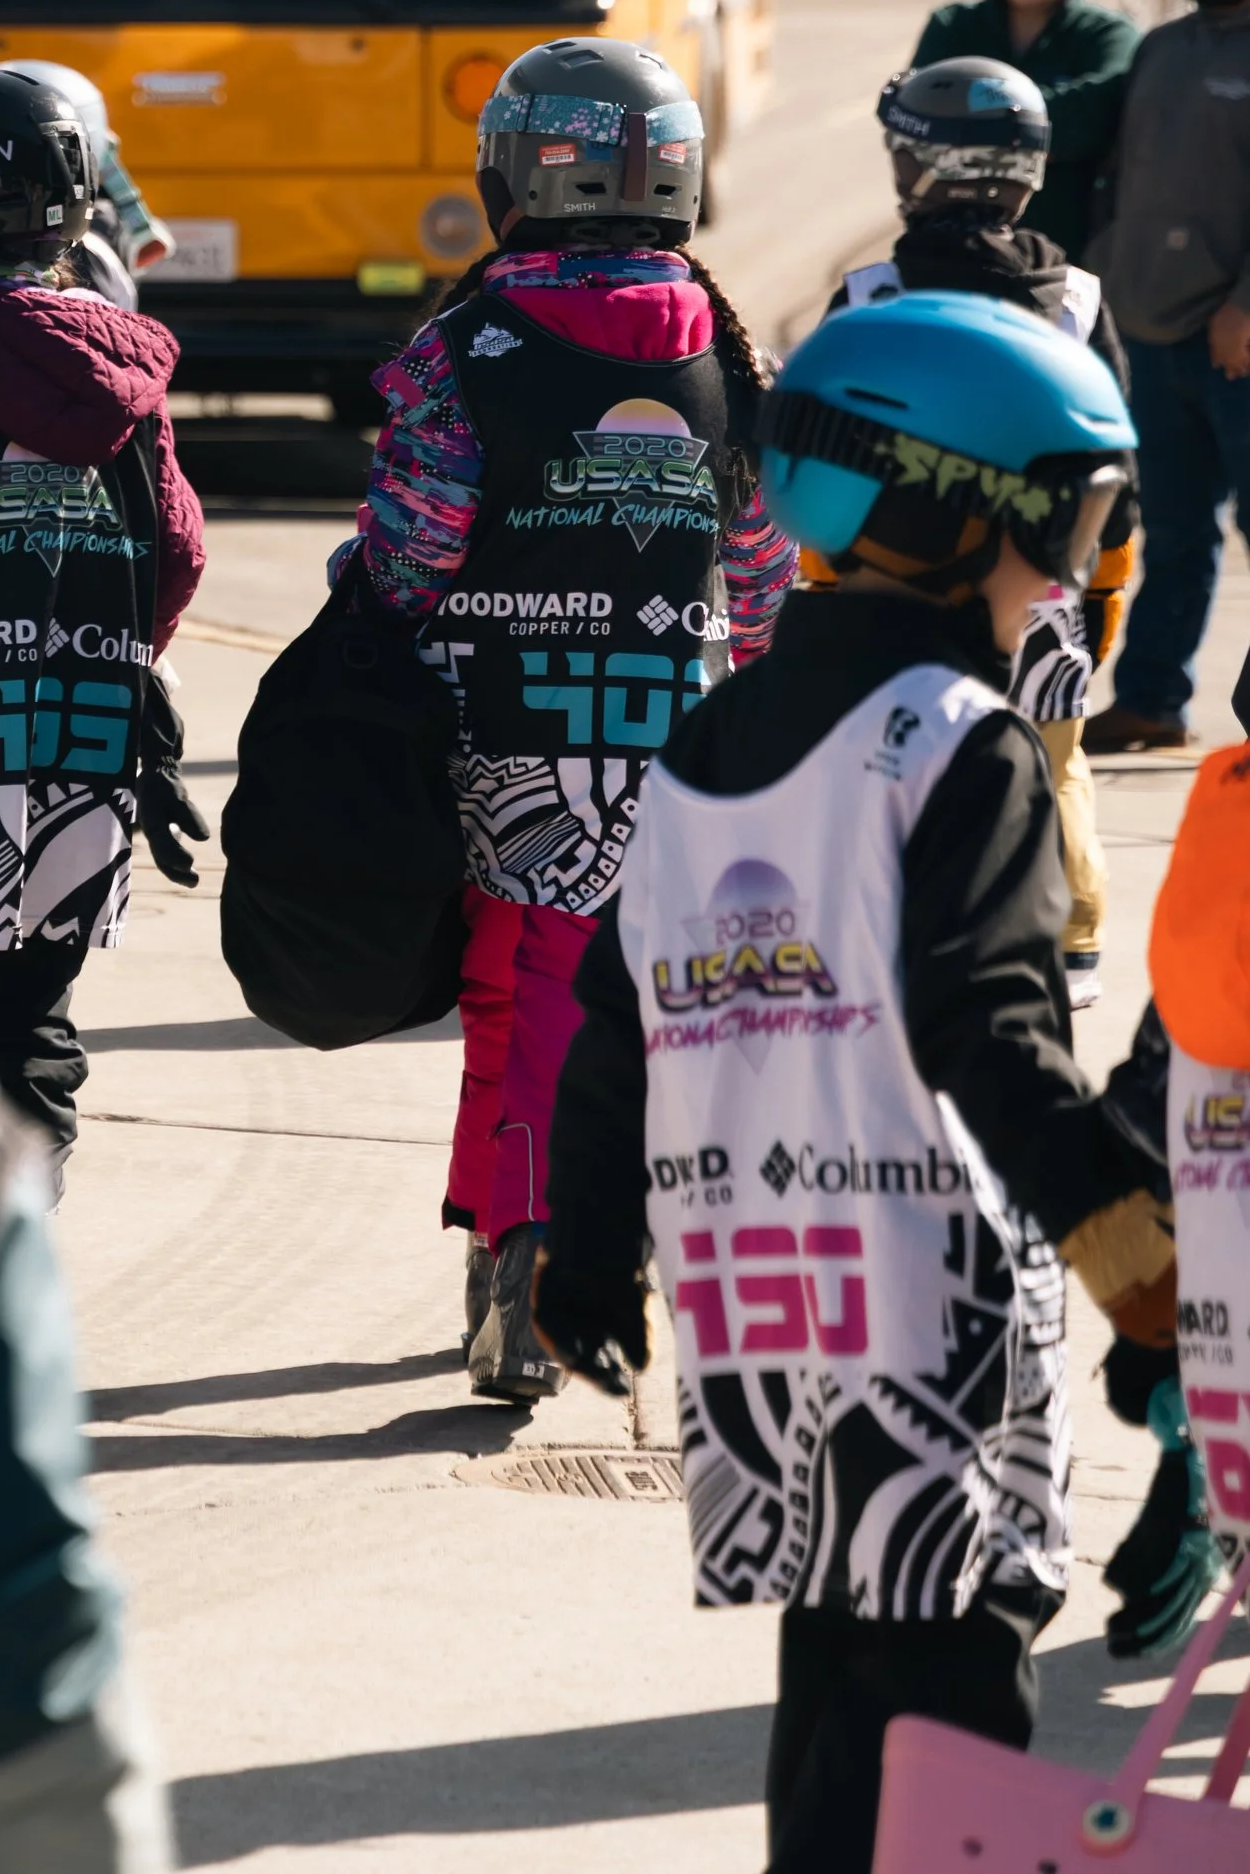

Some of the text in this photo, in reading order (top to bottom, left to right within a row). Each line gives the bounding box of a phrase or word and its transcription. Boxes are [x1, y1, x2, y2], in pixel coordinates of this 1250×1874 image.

[563, 202, 596, 213] SMITH
[603, 435, 687, 458] 2020
[10, 463, 80, 484] 2020
[547, 458, 718, 508] USASA
[505, 502, 605, 530] NATIONAL
[509, 621, 569, 636] COPPER
[590, 622, 611, 635] CO
[18, 648, 38, 662] CO
